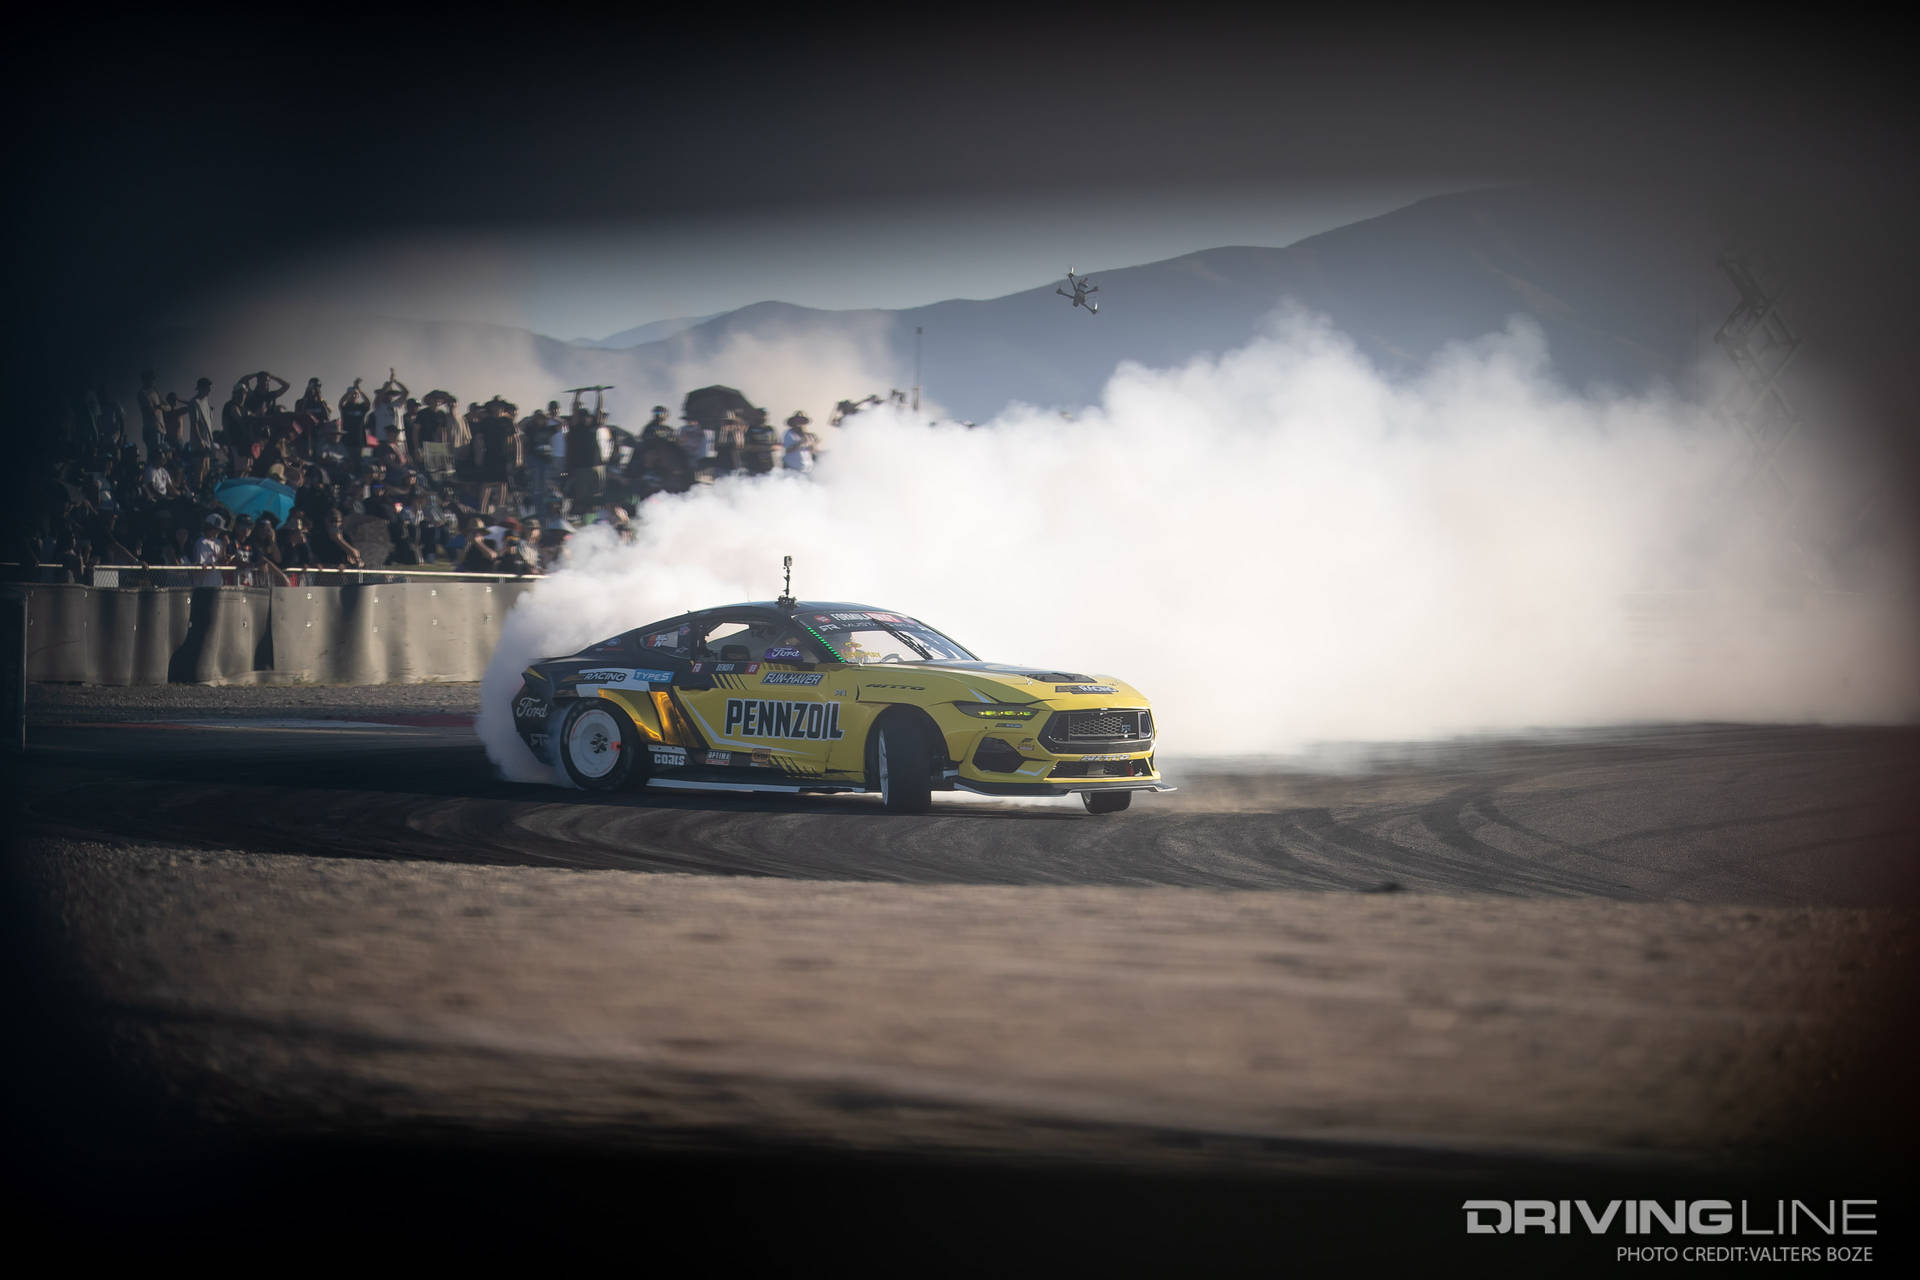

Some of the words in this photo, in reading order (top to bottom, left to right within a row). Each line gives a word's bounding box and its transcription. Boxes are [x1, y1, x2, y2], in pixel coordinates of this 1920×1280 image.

[771, 648, 800, 658] Ford
[584, 672, 626, 681] RACING
[763, 673, 822, 684] FUN-HAVER
[516, 697, 548, 718] Ford
[725, 698, 845, 741] PENNZOIL
